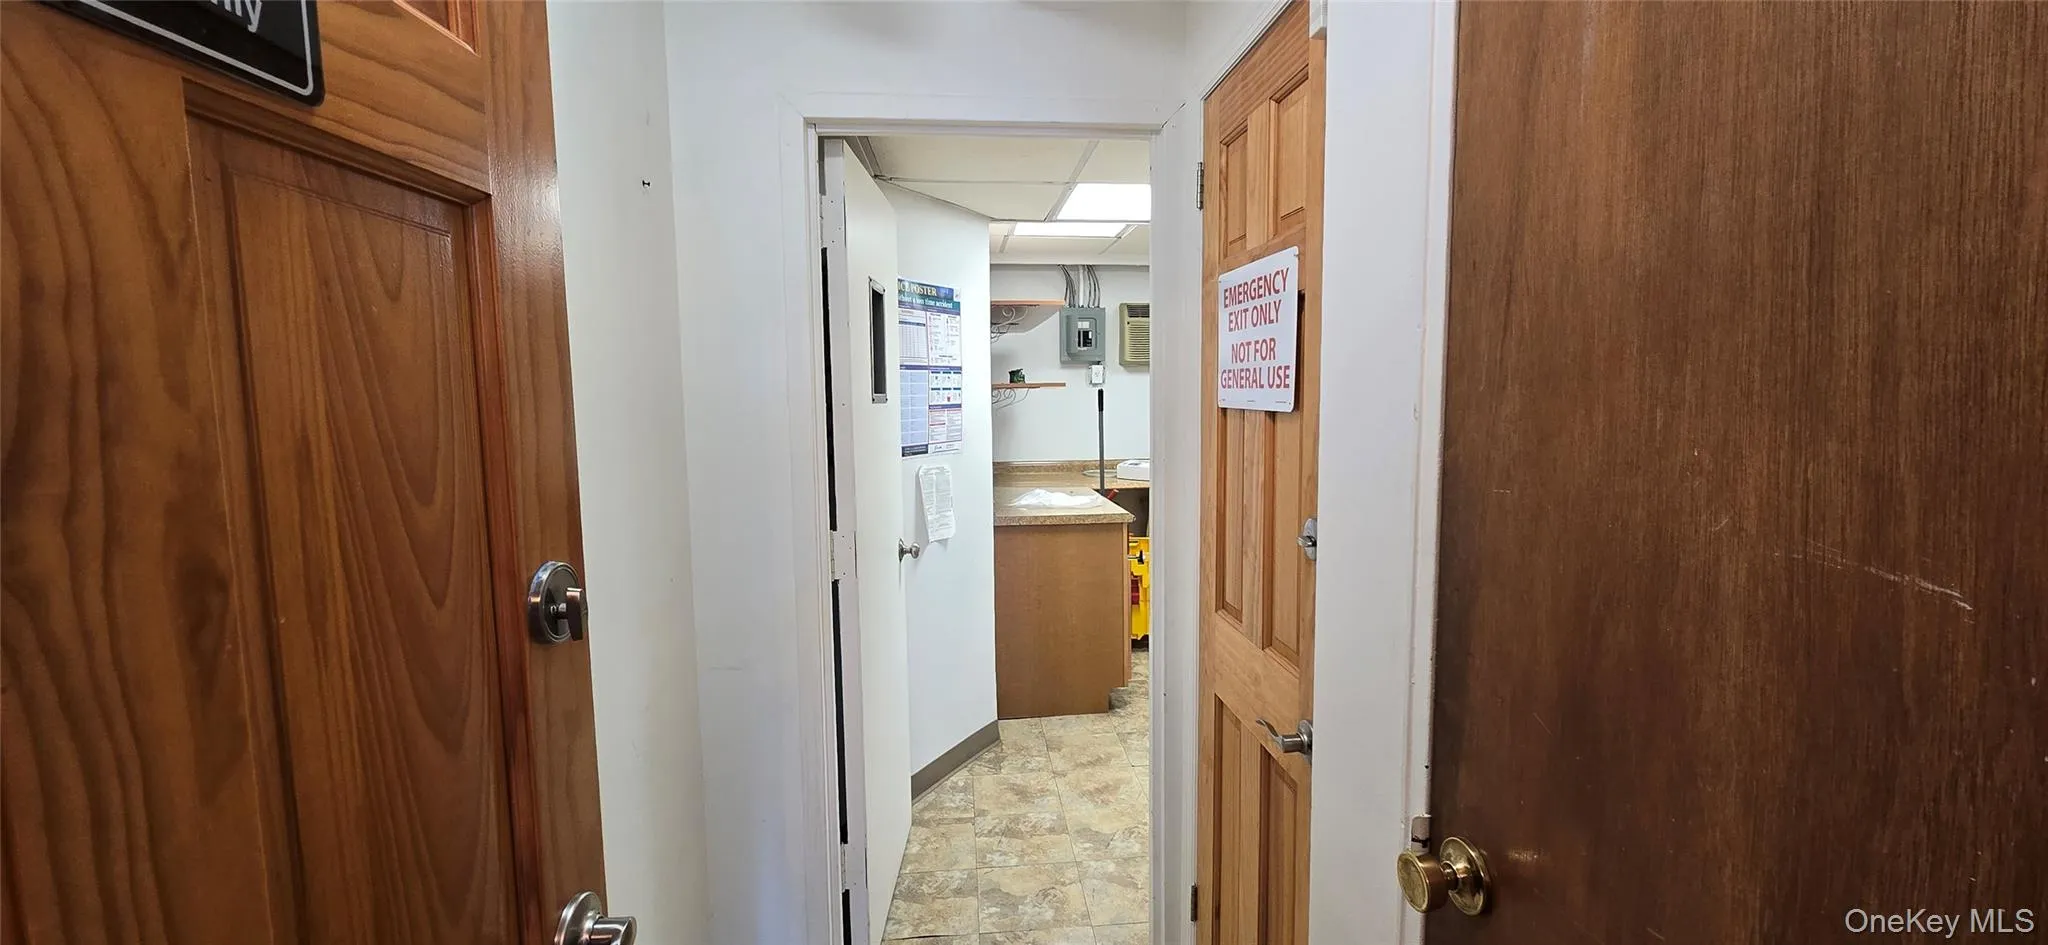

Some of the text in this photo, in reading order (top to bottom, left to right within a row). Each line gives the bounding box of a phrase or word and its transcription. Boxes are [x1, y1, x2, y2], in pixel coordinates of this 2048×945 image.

[1224, 268, 1289, 309] EMERGENCY
[1228, 299, 1282, 333] EXIT ONLY
[1231, 337, 1276, 364] NOT FOR
[1220, 365, 1291, 390] GENERAL USE
